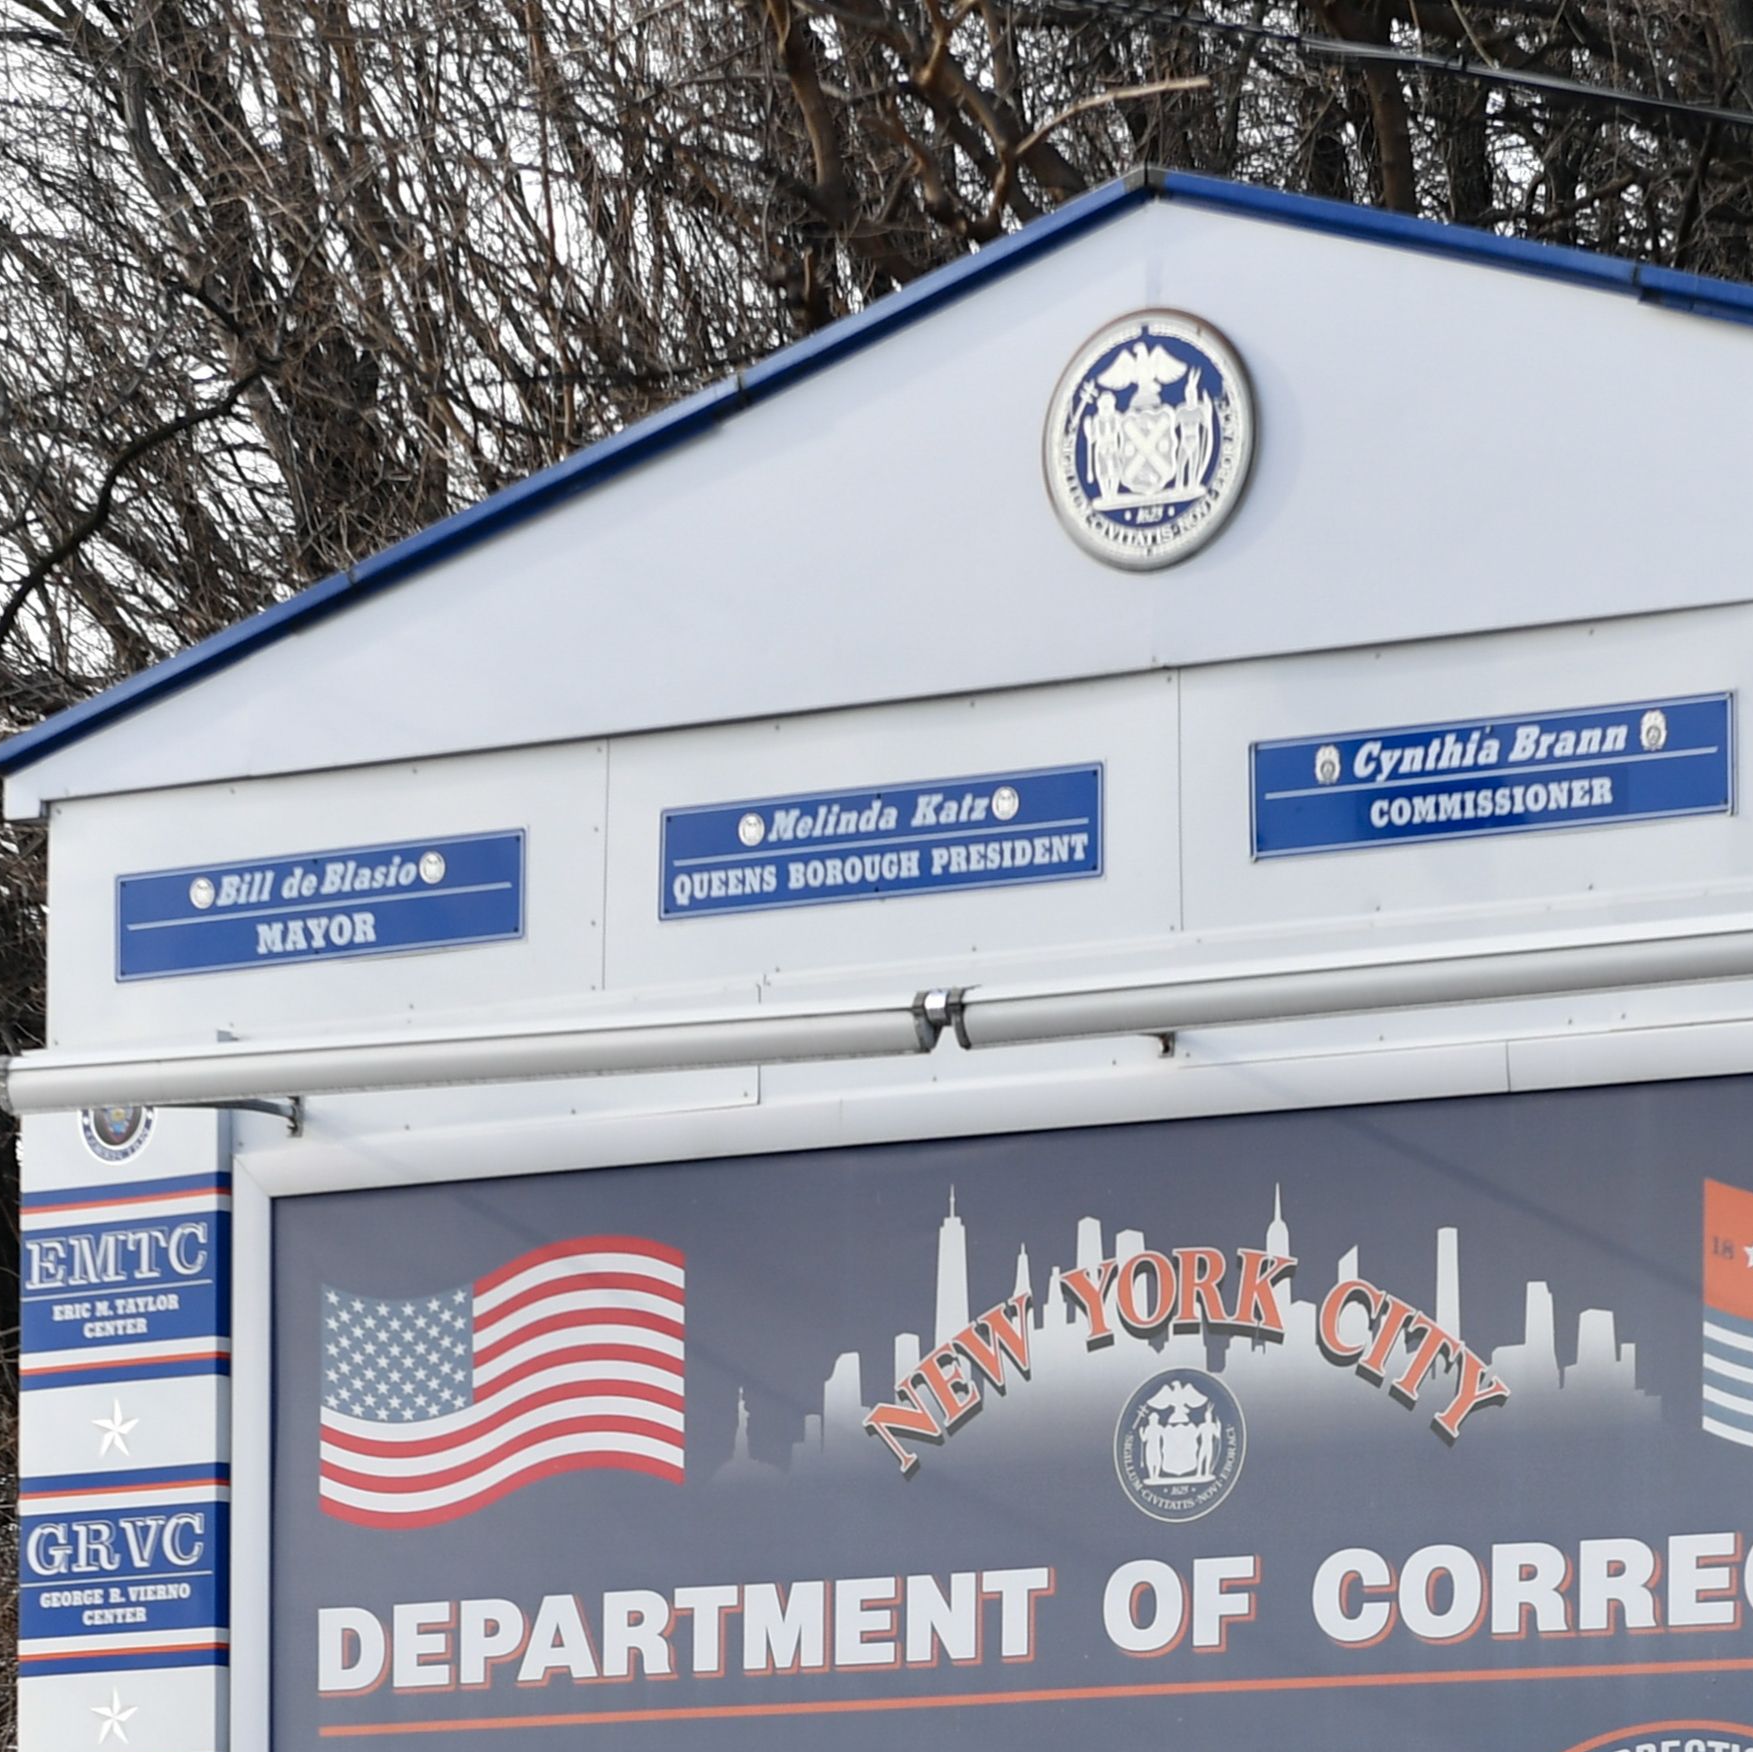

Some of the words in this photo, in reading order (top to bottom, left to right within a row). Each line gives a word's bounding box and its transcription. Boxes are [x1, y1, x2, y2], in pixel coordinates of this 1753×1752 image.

[1352, 730, 1501, 783] Cynthia
[1509, 723, 1628, 764] Brann
[767, 799, 899, 843] Melinda
[910, 793, 992, 827] Katz
[1369, 776, 1613, 828] COMMISSIONER
[215, 869, 275, 907] Bill
[281, 867, 316, 900] de
[320, 855, 418, 895] Blasio
[673, 865, 777, 906] QUEENS
[788, 851, 920, 889] BOROUGH
[930, 833, 1089, 875] PRESIDENT
[256, 911, 377, 955] MAYOR
[25, 1222, 208, 1290] EMTC
[1710, 1236, 1734, 1260] 18
[52, 1301, 91, 1321] ERIC
[94, 1300, 114, 1317] M.
[115, 1294, 179, 1315] TAYLOR
[83, 1318, 148, 1339] CENTER
[863, 1291, 1036, 1478] NEW
[1060, 1247, 1297, 1348] YORK
[1317, 1278, 1511, 1442] CITY
[26, 1512, 204, 1576] GRVC
[39, 1588, 103, 1609] GEORGE
[128, 1583, 191, 1602] VIERNO
[82, 1607, 147, 1626] CENTER
[317, 1566, 1054, 1695] DEPARTMENT
[1102, 1555, 1257, 1655] OF
